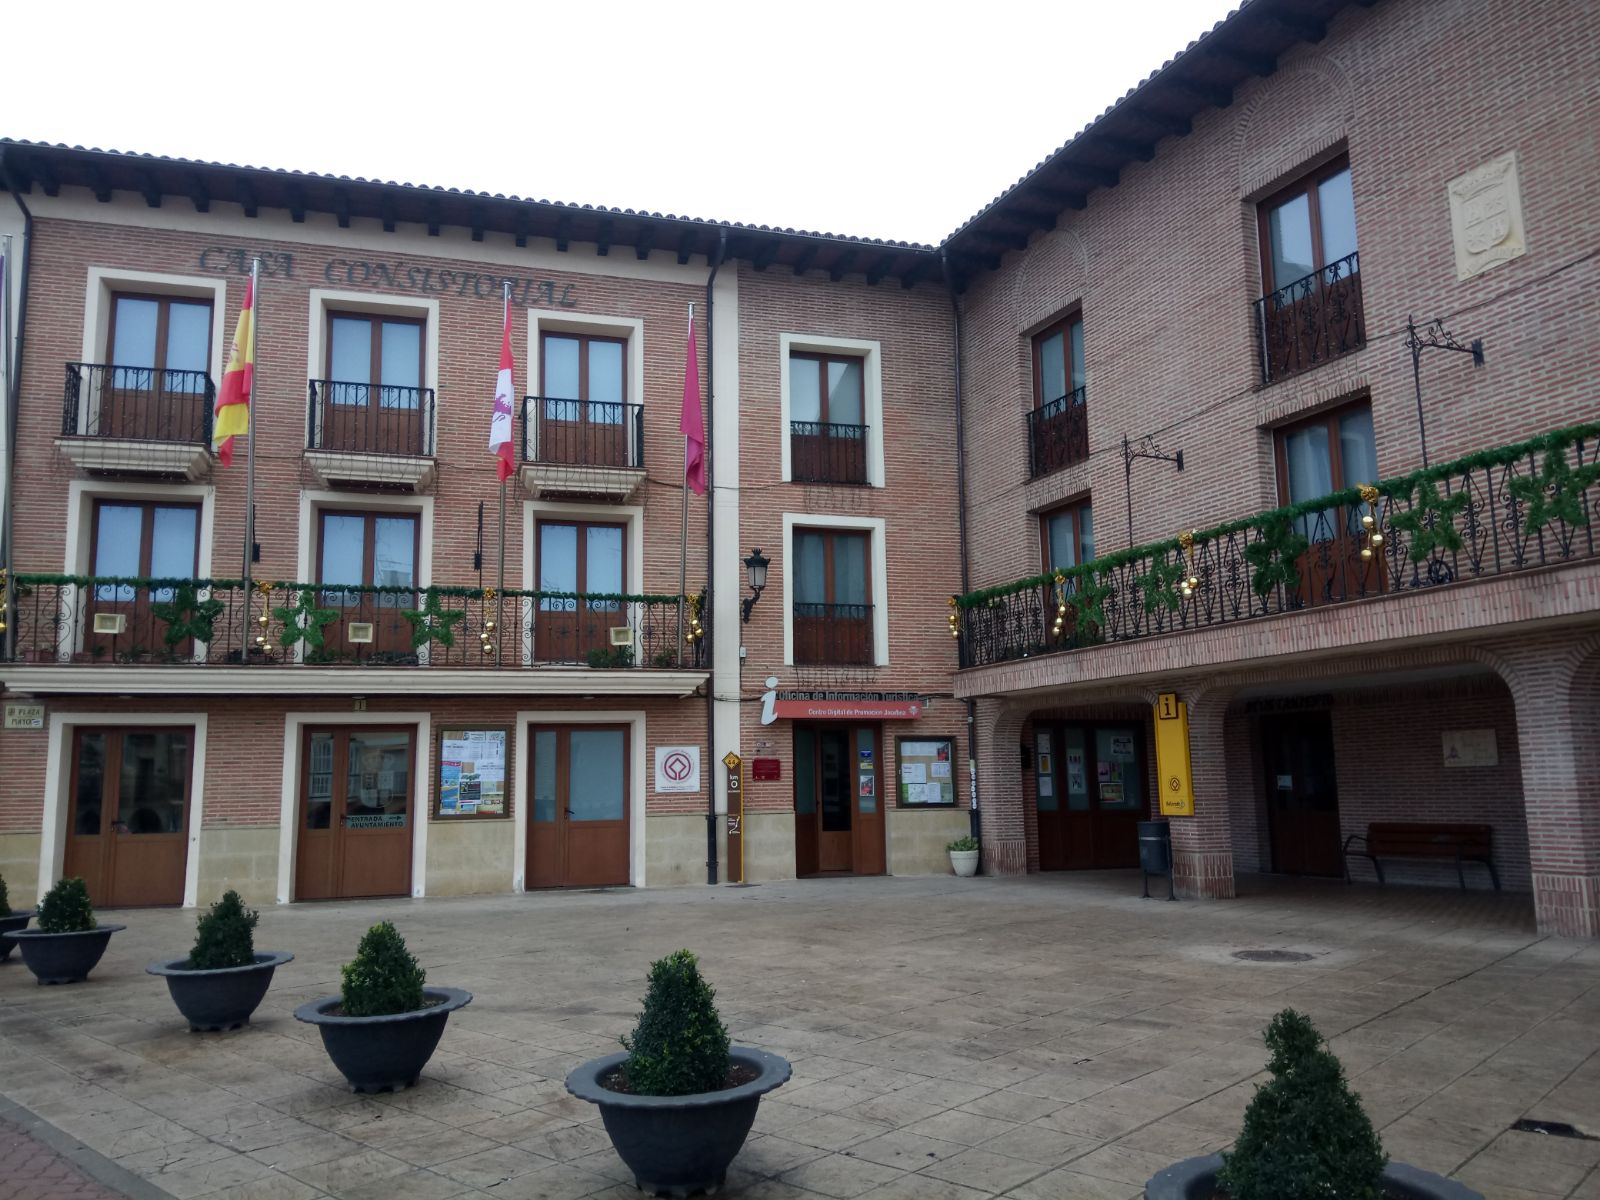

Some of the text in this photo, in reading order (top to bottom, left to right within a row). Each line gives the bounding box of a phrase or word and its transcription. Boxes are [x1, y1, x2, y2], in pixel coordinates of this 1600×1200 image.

[200, 246, 577, 307] CASA CONSISTORIAL
[779, 690, 810, 701] Oficina
[812, 691, 824, 701] de
[826, 691, 879, 701] Información
[18, 708, 40, 716] PLAZA
[828, 708, 846, 717] Digital
[12, 718, 35, 726] MAYO
[730, 780, 738, 789] 0
[350, 821, 404, 829] AYUNTAMIENTO
